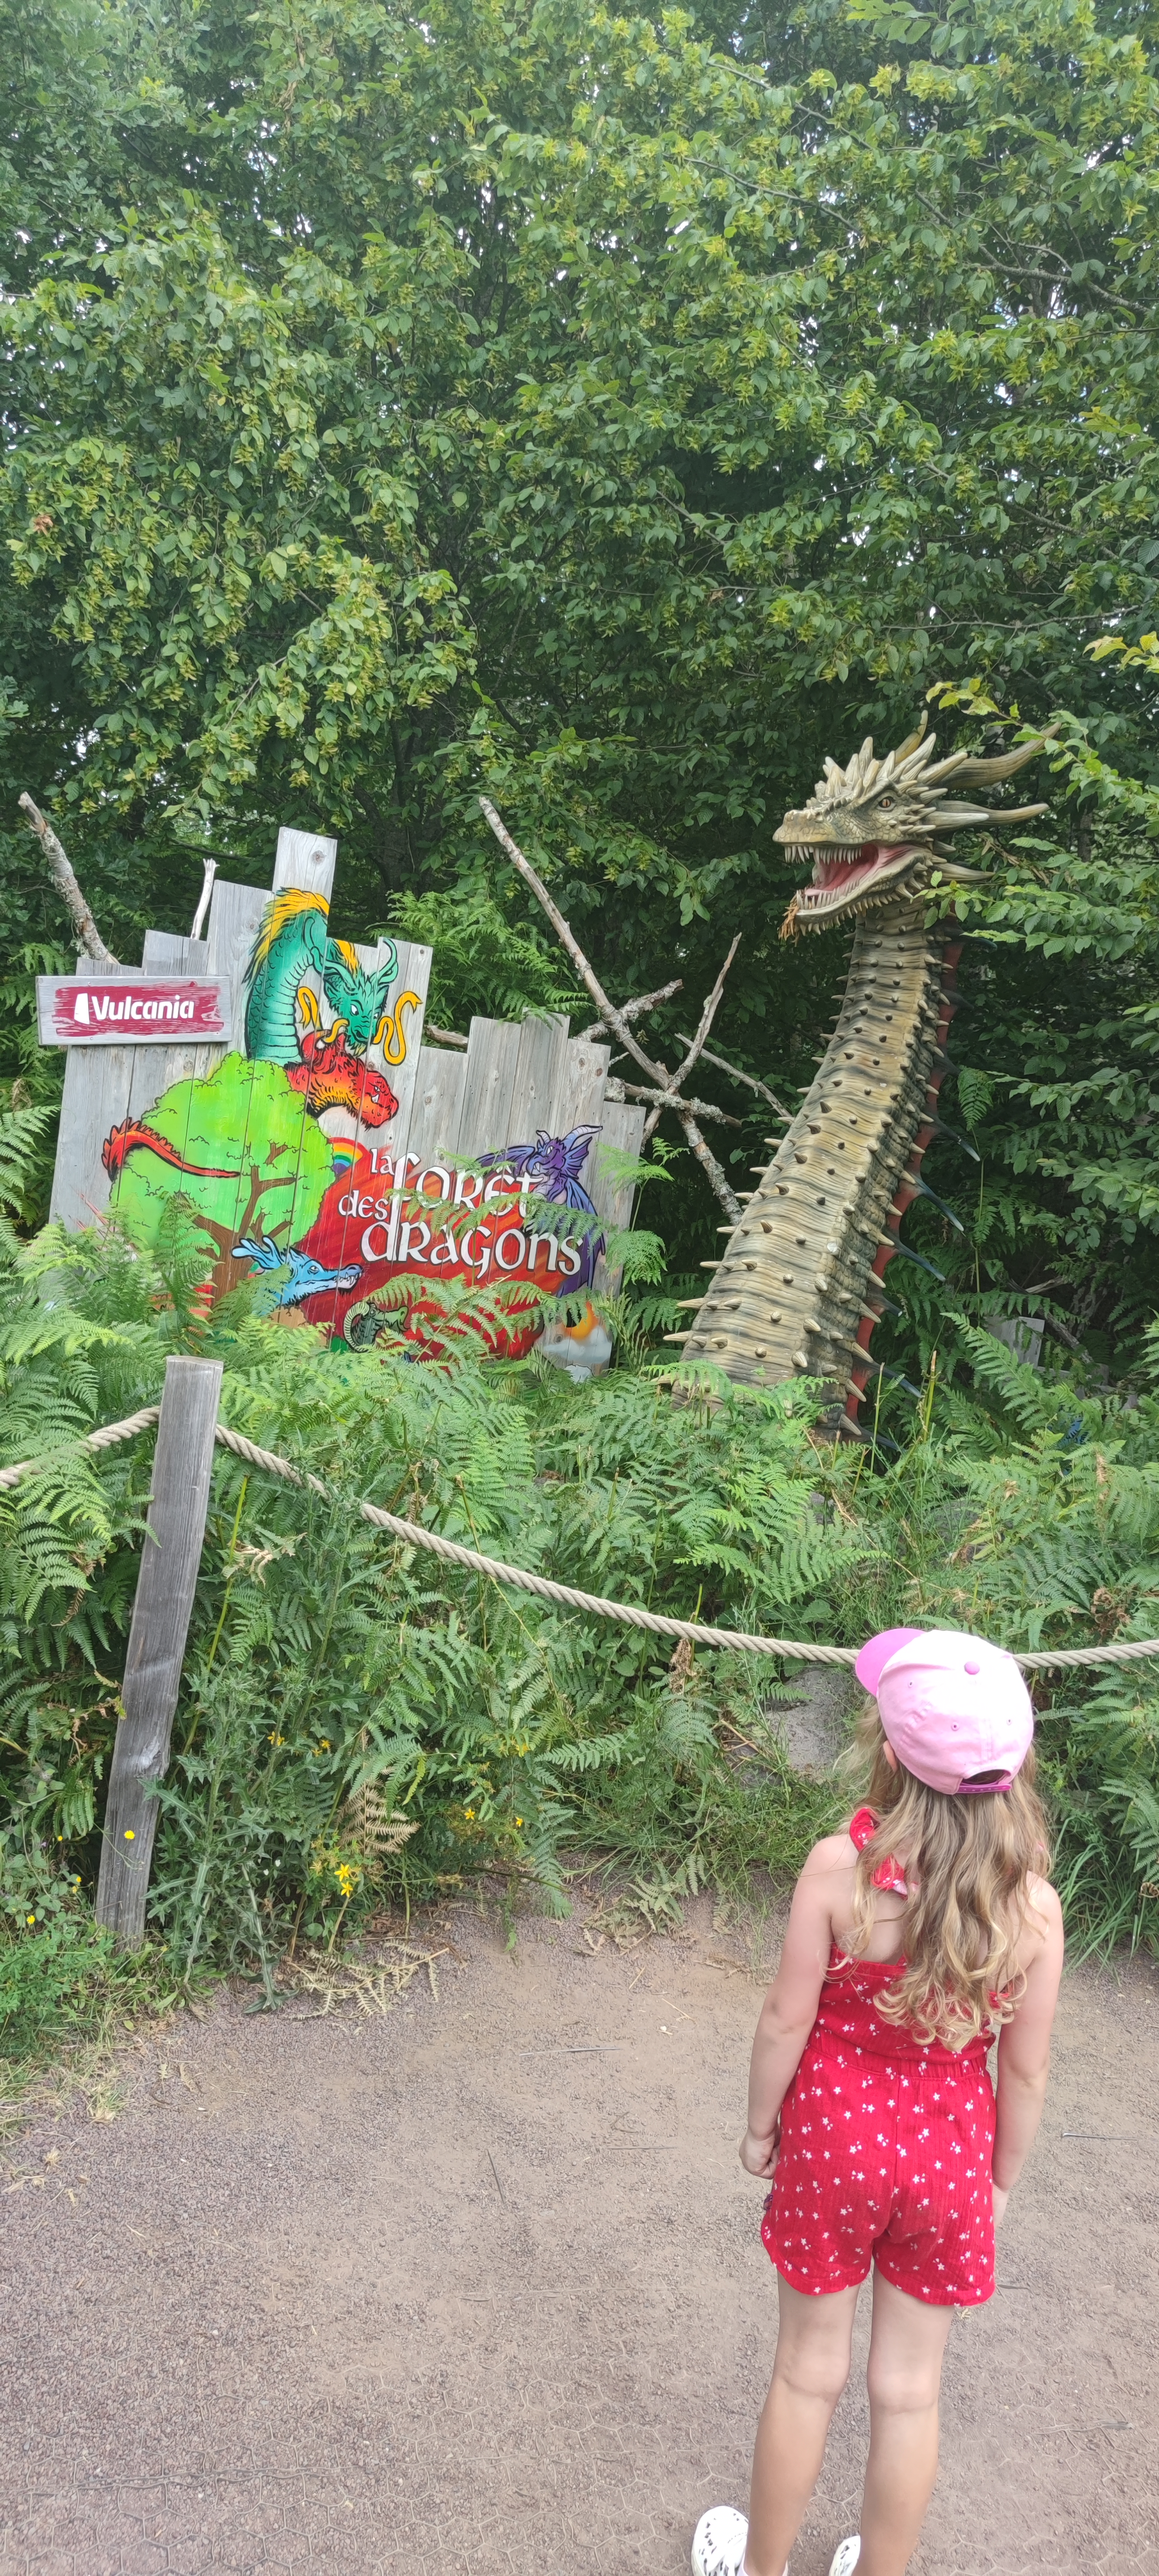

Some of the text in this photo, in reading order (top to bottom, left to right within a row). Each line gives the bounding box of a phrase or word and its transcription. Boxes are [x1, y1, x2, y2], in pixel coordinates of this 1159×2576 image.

[91, 995, 195, 1021] Vulcania
[370, 1148, 395, 1175] la
[338, 1190, 389, 1220] des
